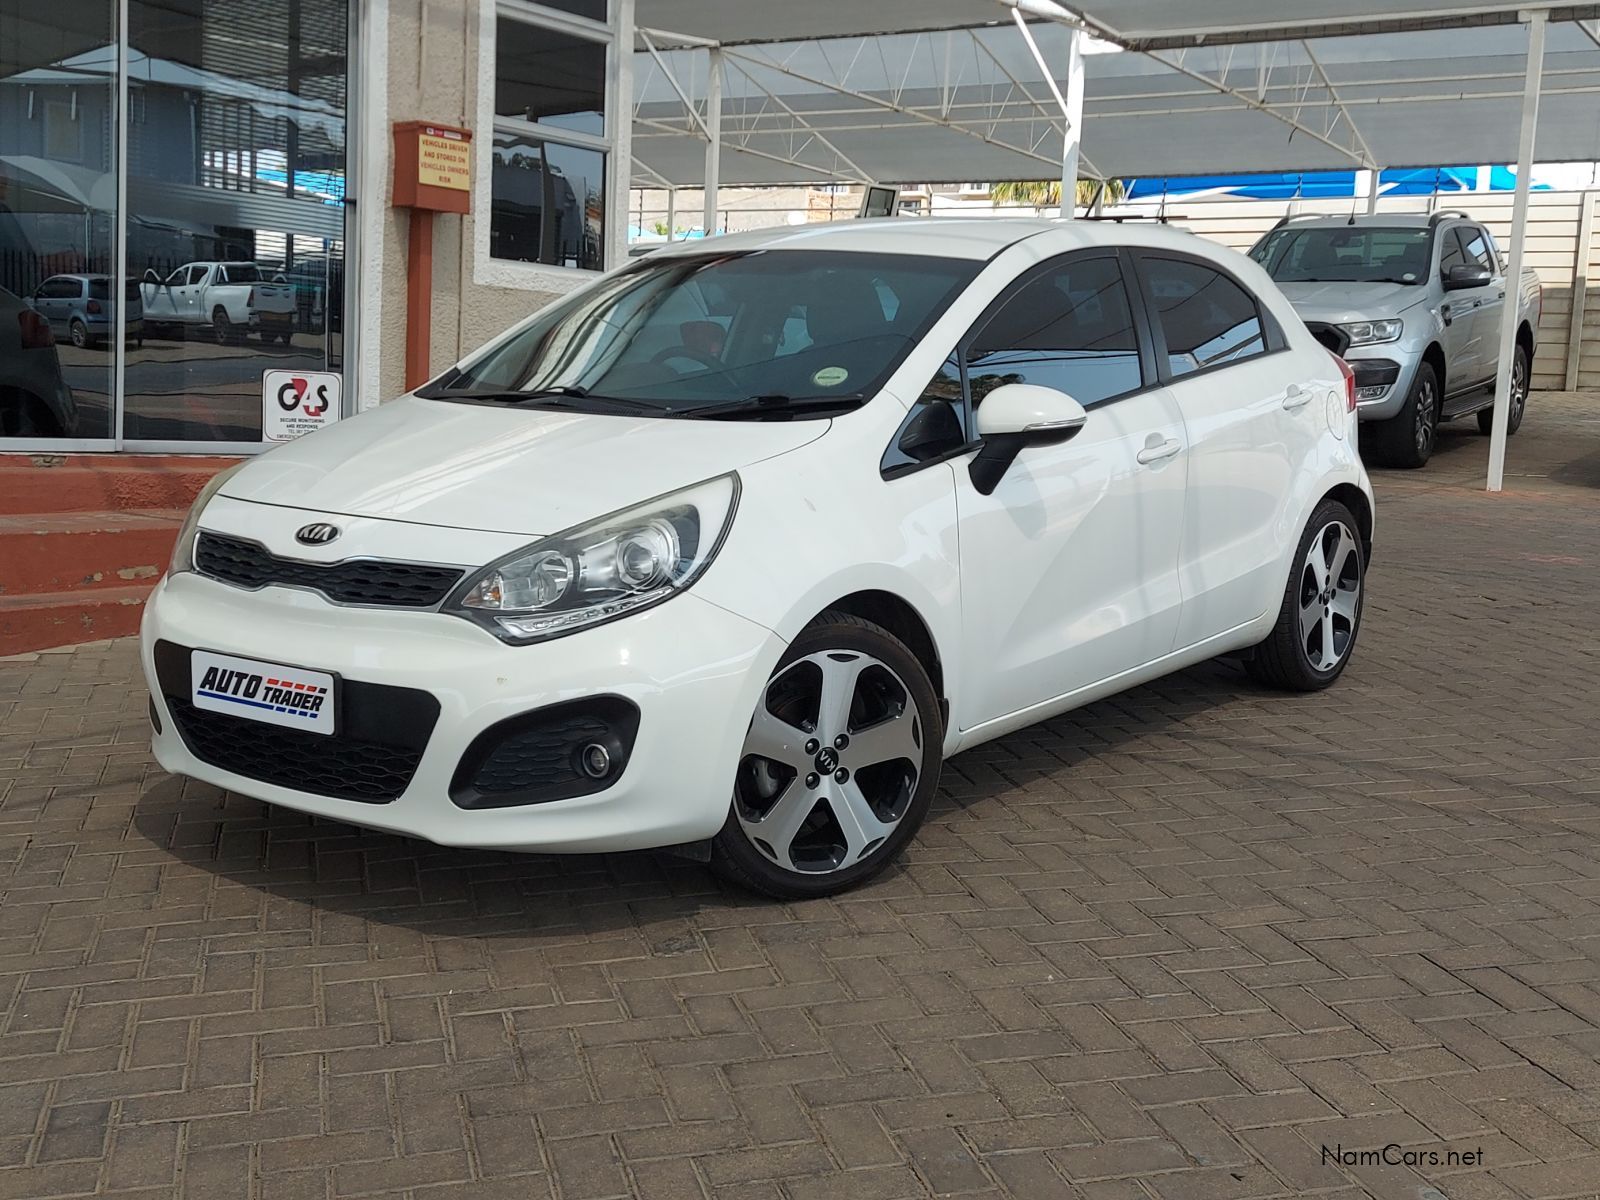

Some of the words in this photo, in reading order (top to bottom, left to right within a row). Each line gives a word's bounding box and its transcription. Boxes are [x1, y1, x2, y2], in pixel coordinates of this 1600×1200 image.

[422, 139, 448, 150] VEHICLES
[448, 143, 468, 153] DRIVEN
[424, 150, 435, 158] AND
[436, 152, 457, 162] STORED
[458, 156, 466, 164] ON
[420, 162, 446, 172] VEHICLES
[447, 166, 469, 176] OWNERS
[438, 175, 452, 183] RISK
[277, 378, 329, 417] G4S
[298, 525, 332, 541] KIA
[199, 666, 263, 699] AUTO
[262, 686, 324, 712] TRADER
[819, 750, 837, 772] KIA
